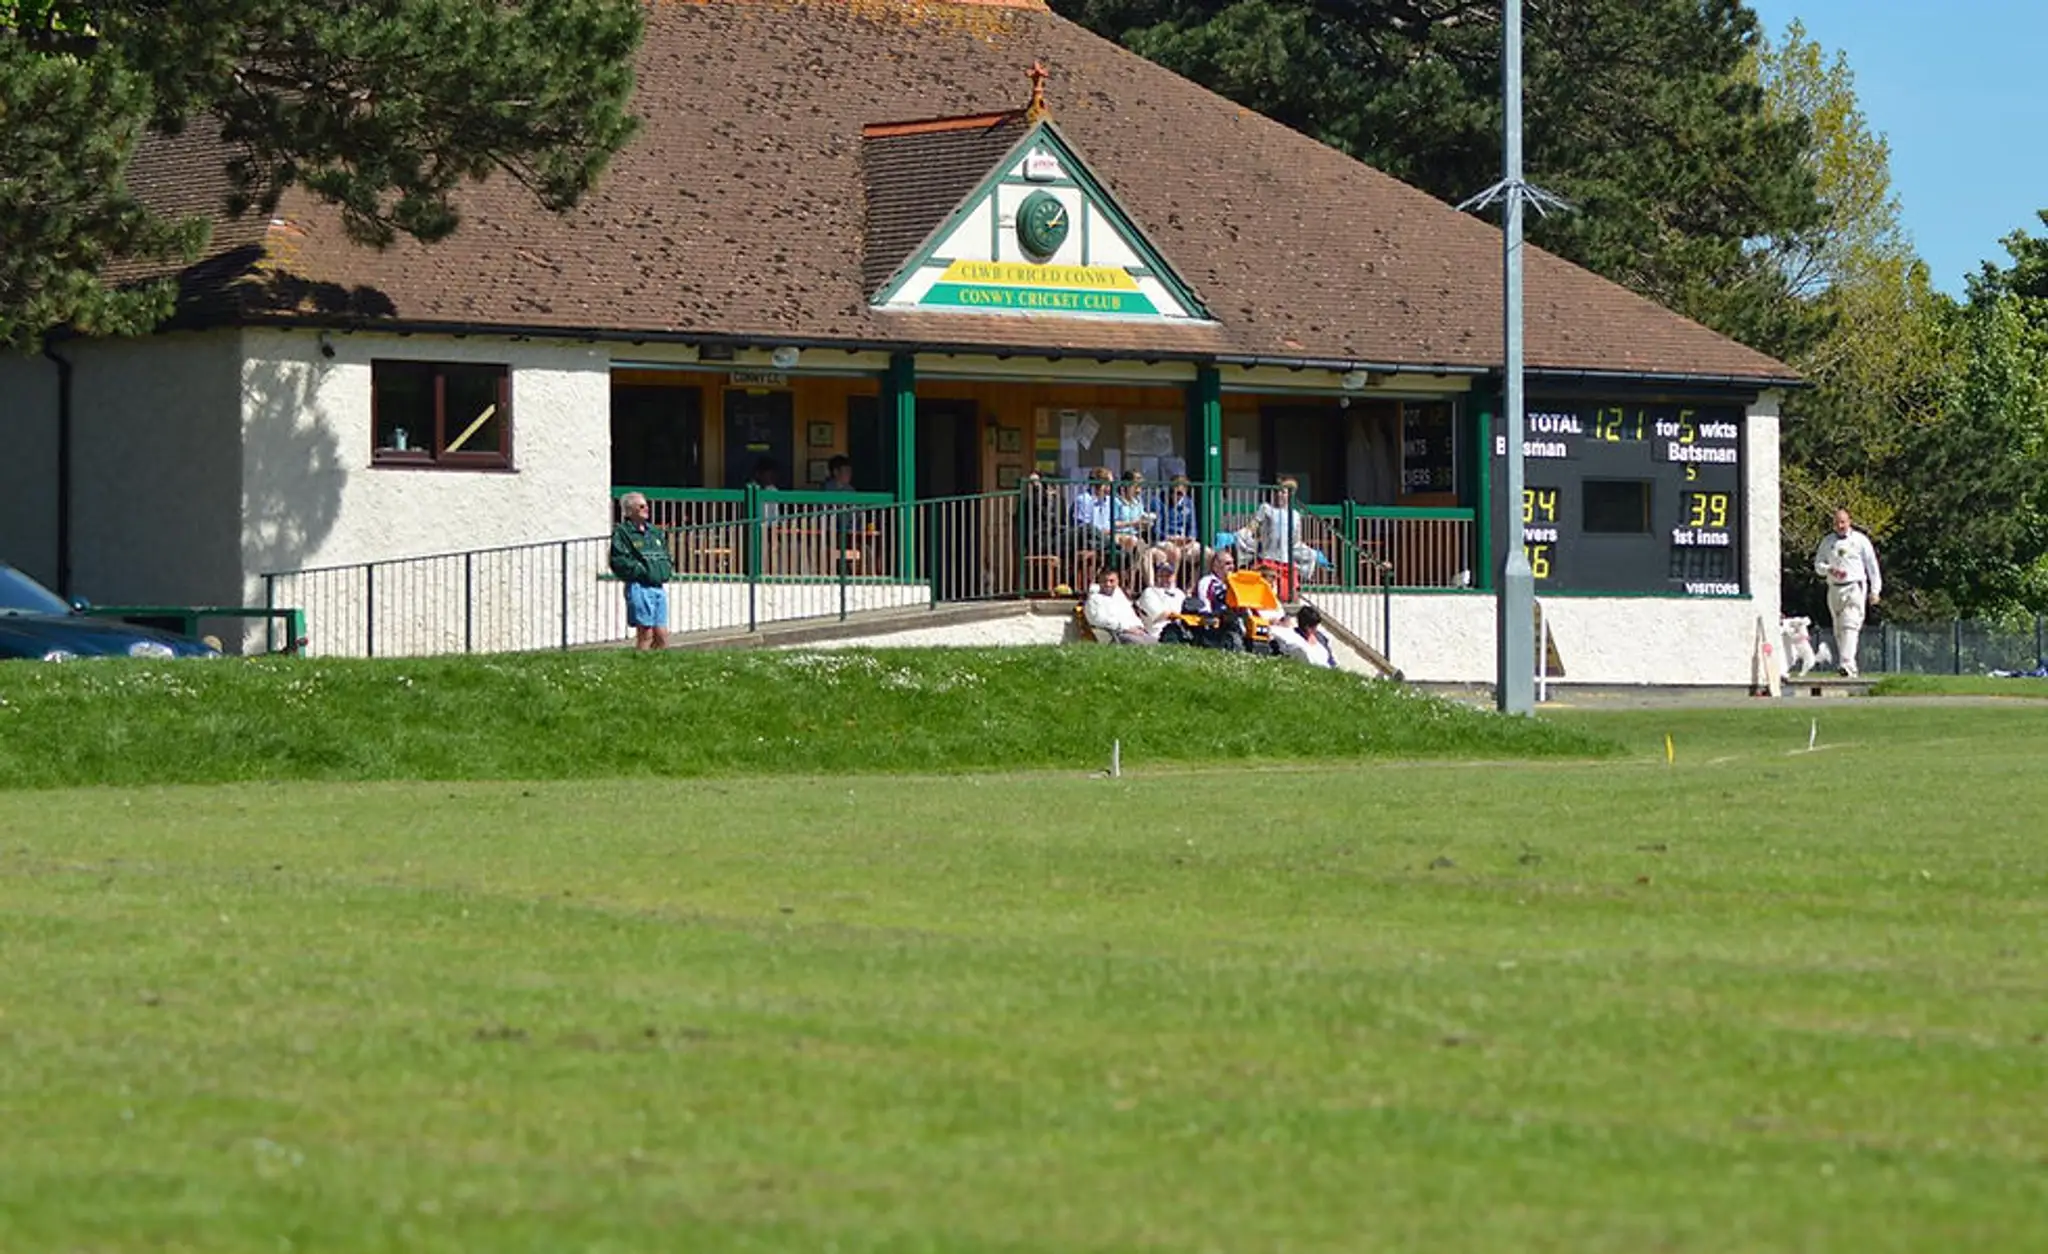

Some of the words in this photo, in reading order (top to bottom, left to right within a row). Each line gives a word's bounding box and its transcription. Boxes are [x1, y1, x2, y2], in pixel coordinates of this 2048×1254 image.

[959, 288, 1013, 304] CONWY
[1019, 291, 1079, 308] CRICKET
[1084, 294, 1122, 310] CLUB
[1528, 413, 1583, 434] TOTAL
[1656, 418, 1680, 437] for
[1699, 420, 1738, 439] wkts
[1496, 435, 1567, 458] Bsman
[1668, 442, 1738, 463] Batsman
[1690, 493, 1728, 527] 39
[1522, 528, 1558, 542] vers
[1672, 528, 1694, 545] 1st
[1685, 582, 1740, 595] VISITORS
